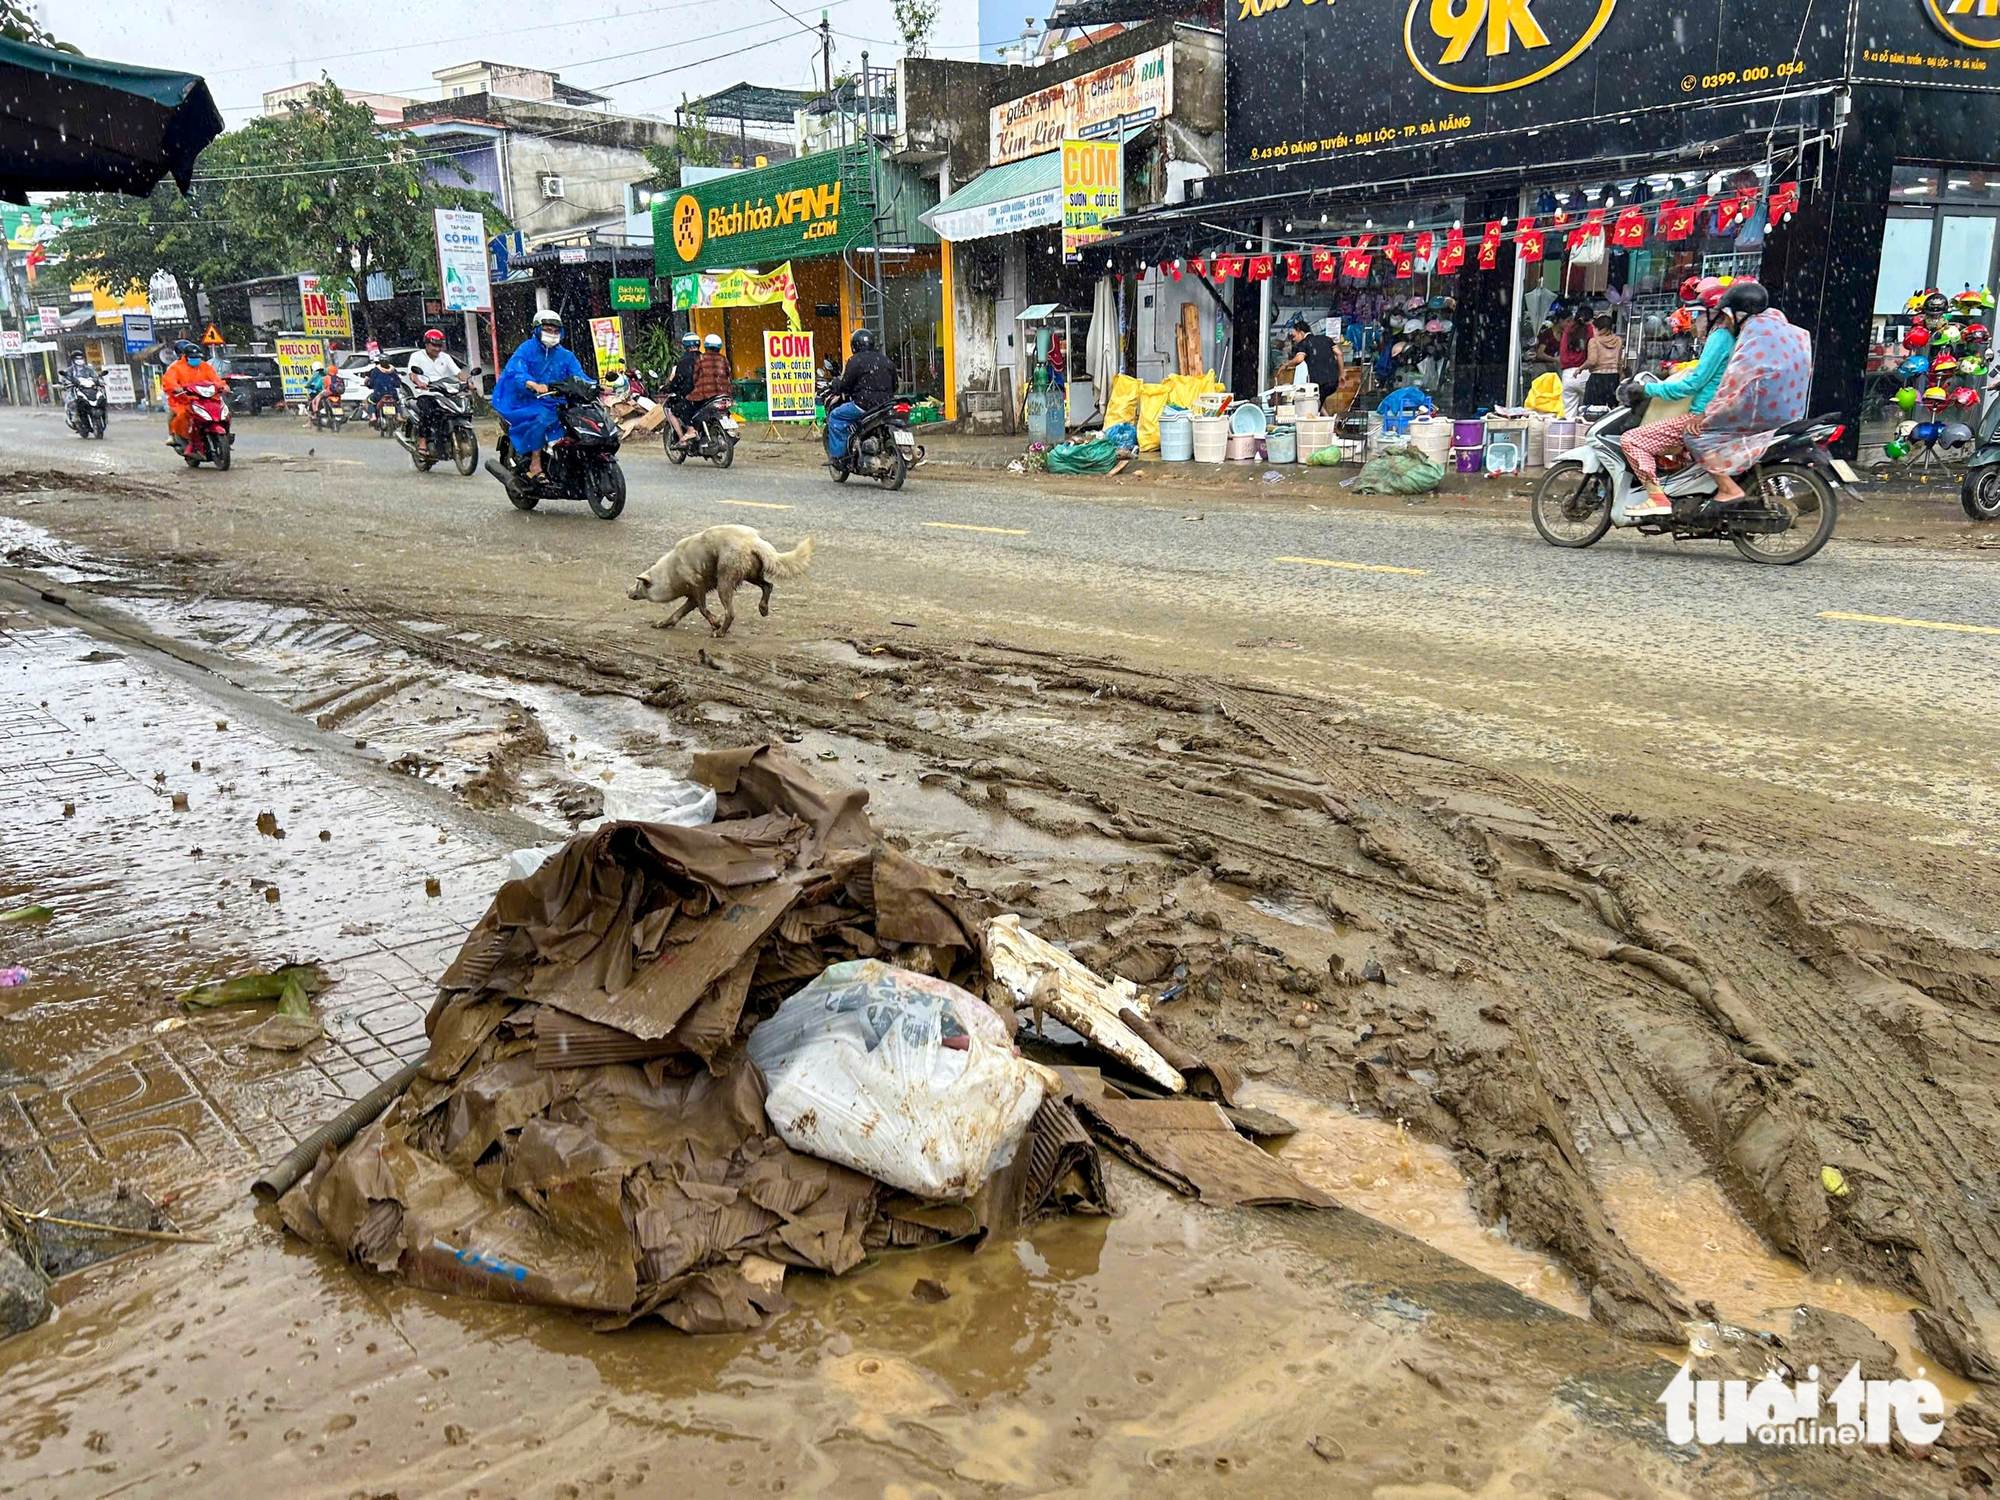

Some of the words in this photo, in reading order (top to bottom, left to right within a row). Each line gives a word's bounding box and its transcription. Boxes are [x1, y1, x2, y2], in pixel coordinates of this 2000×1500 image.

[1261, 147, 1271, 159] 43
[1273, 140, 1288, 158] ĐỖ
[1320, 131, 1348, 149] TUYỂN
[1355, 133, 1371, 146] ĐẠI
[1375, 126, 1395, 144] LỘC
[1404, 125, 1418, 138] TP.
[1420, 118, 1436, 135] ĐÀ
[1438, 113, 1471, 131] NẴNG
[1064, 144, 1117, 187] CƠM
[708, 203, 742, 239] Bách
[745, 198, 772, 231] hóa
[773, 181, 841, 226] XANH
[618, 285, 634, 293] Bách
[618, 294, 646, 303] XANH
[769, 334, 810, 358] CƠM
